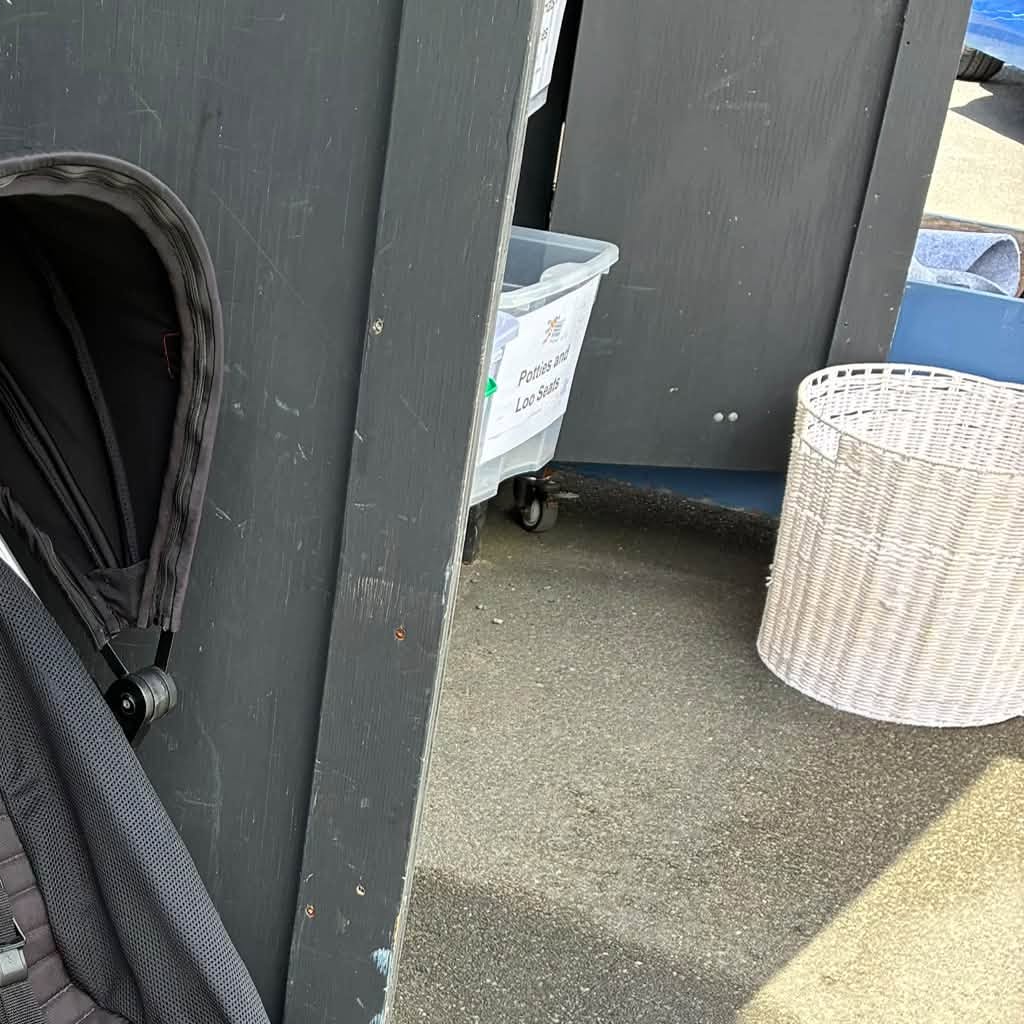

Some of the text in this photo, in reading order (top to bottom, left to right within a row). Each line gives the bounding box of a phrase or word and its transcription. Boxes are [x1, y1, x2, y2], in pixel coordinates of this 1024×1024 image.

[518, 344, 571, 386] Potties and
[515, 377, 560, 413] Loo Seats
